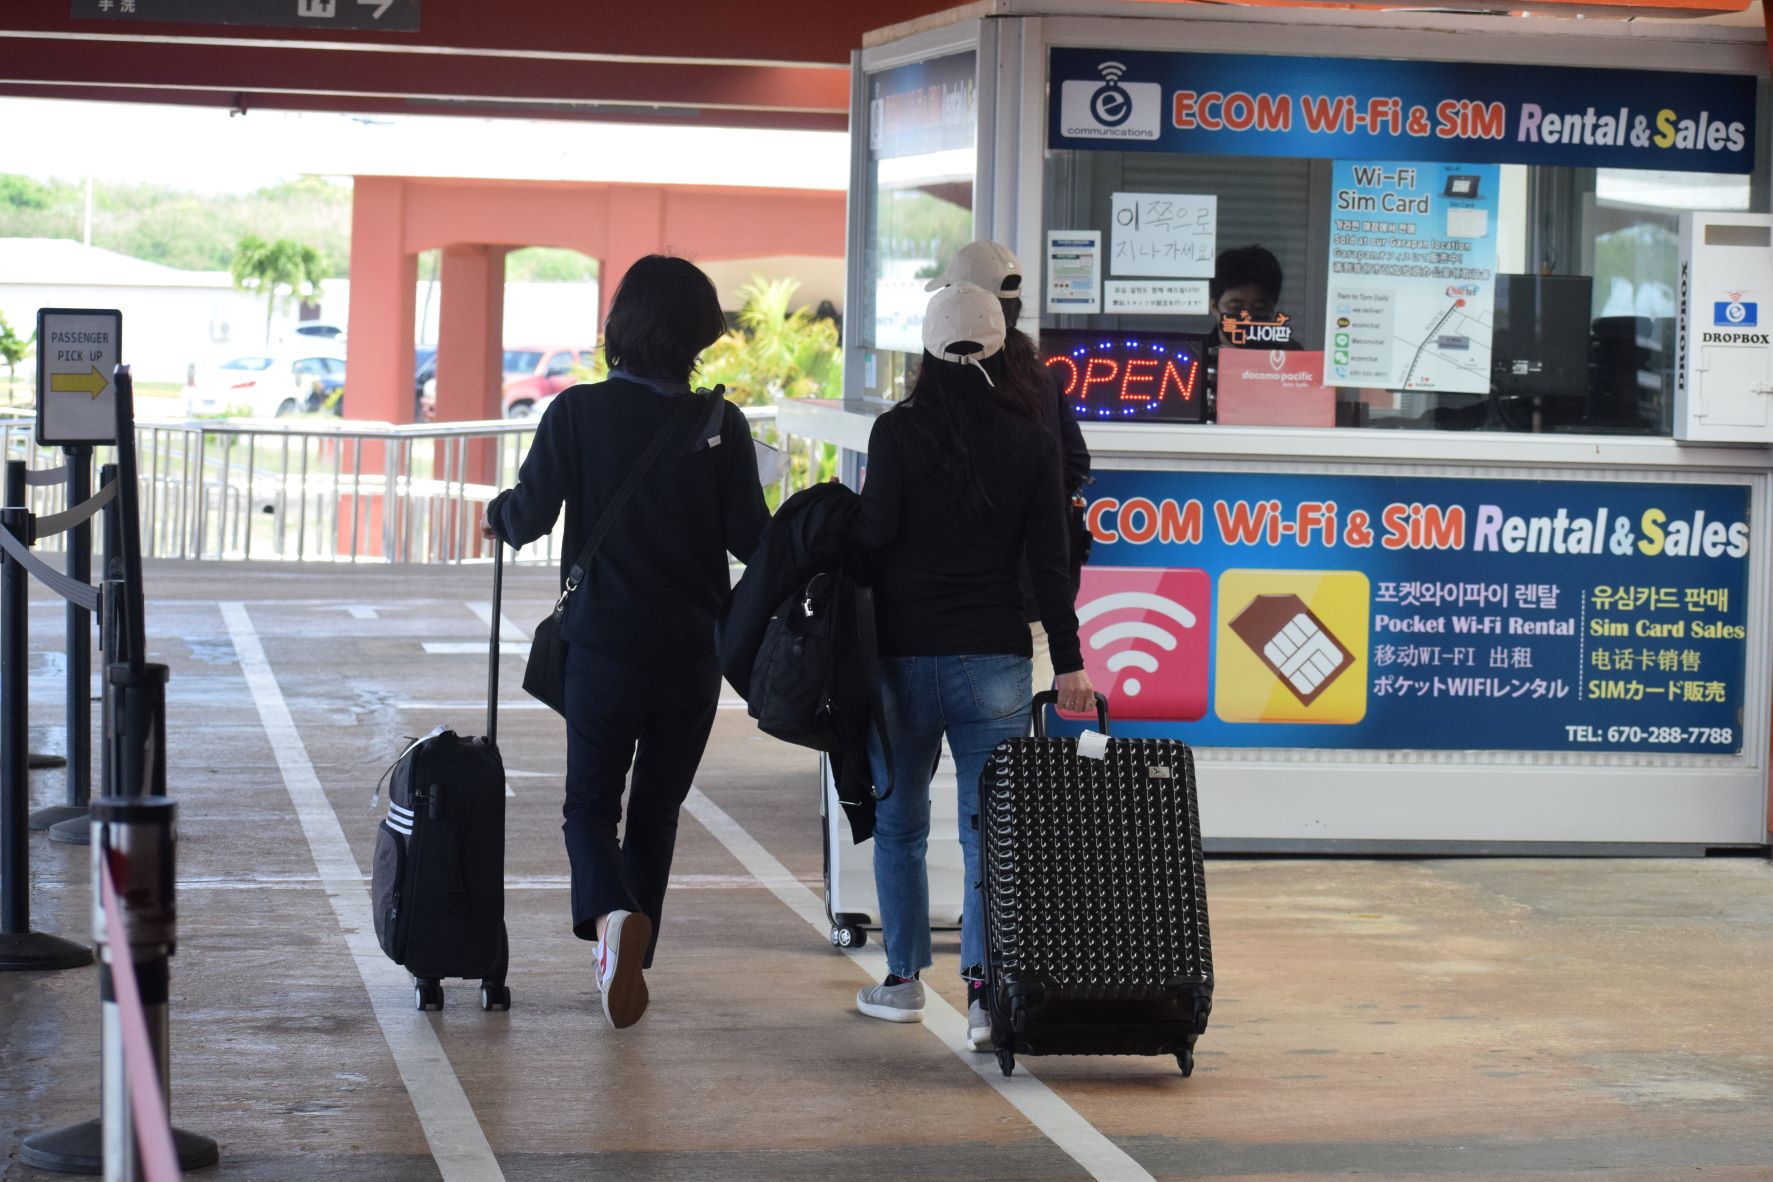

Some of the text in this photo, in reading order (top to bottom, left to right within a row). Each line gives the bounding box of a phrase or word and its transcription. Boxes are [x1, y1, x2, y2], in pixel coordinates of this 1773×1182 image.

[1173, 90, 1291, 132] ECOM
[1302, 95, 1402, 135] Wi-Fi
[1406, 105, 1430, 136] &
[1517, 103, 1628, 146] Rental
[1630, 115, 1650, 148] &
[1653, 109, 1745, 151] Sales
[1067, 126, 1153, 138] communications
[1353, 165, 1416, 189] Wi-Fi
[1337, 190, 1429, 213] Sim Card
[1358, 236, 1368, 246] at
[1370, 238, 1387, 246] our
[1431, 239, 1472, 251] location
[1678, 261, 1688, 390] DROPBOX
[51, 332, 109, 343] PASSENGER
[1702, 332, 1770, 345] DROPBOX
[57, 350, 103, 361] PICK UP
[1242, 370, 1313, 383] docomo pacific
[1073, 497, 1203, 546] COM
[1214, 499, 1337, 548] Wi-Fi
[1344, 510, 1374, 548] &
[1473, 505, 1608, 554] Rental
[1609, 516, 1636, 556] &
[1637, 508, 1749, 558] Sales
[1375, 581, 1560, 609] 포켓와이파이 렌탈
[1591, 585, 1729, 613] 유심카드 판매
[1375, 614, 1575, 636] Pocket Wi-Fi Rental
[1590, 618, 1745, 639] Sim Card Sales
[1374, 644, 1533, 669] 移动WI-FI 出租
[1591, 648, 1702, 672] 电话卡销售
[1373, 675, 1569, 699] ポケットWIFIレンタル
[1588, 680, 1726, 702] SIMカード販売
[1566, 725, 1733, 744] TEL: 670-288-7788
